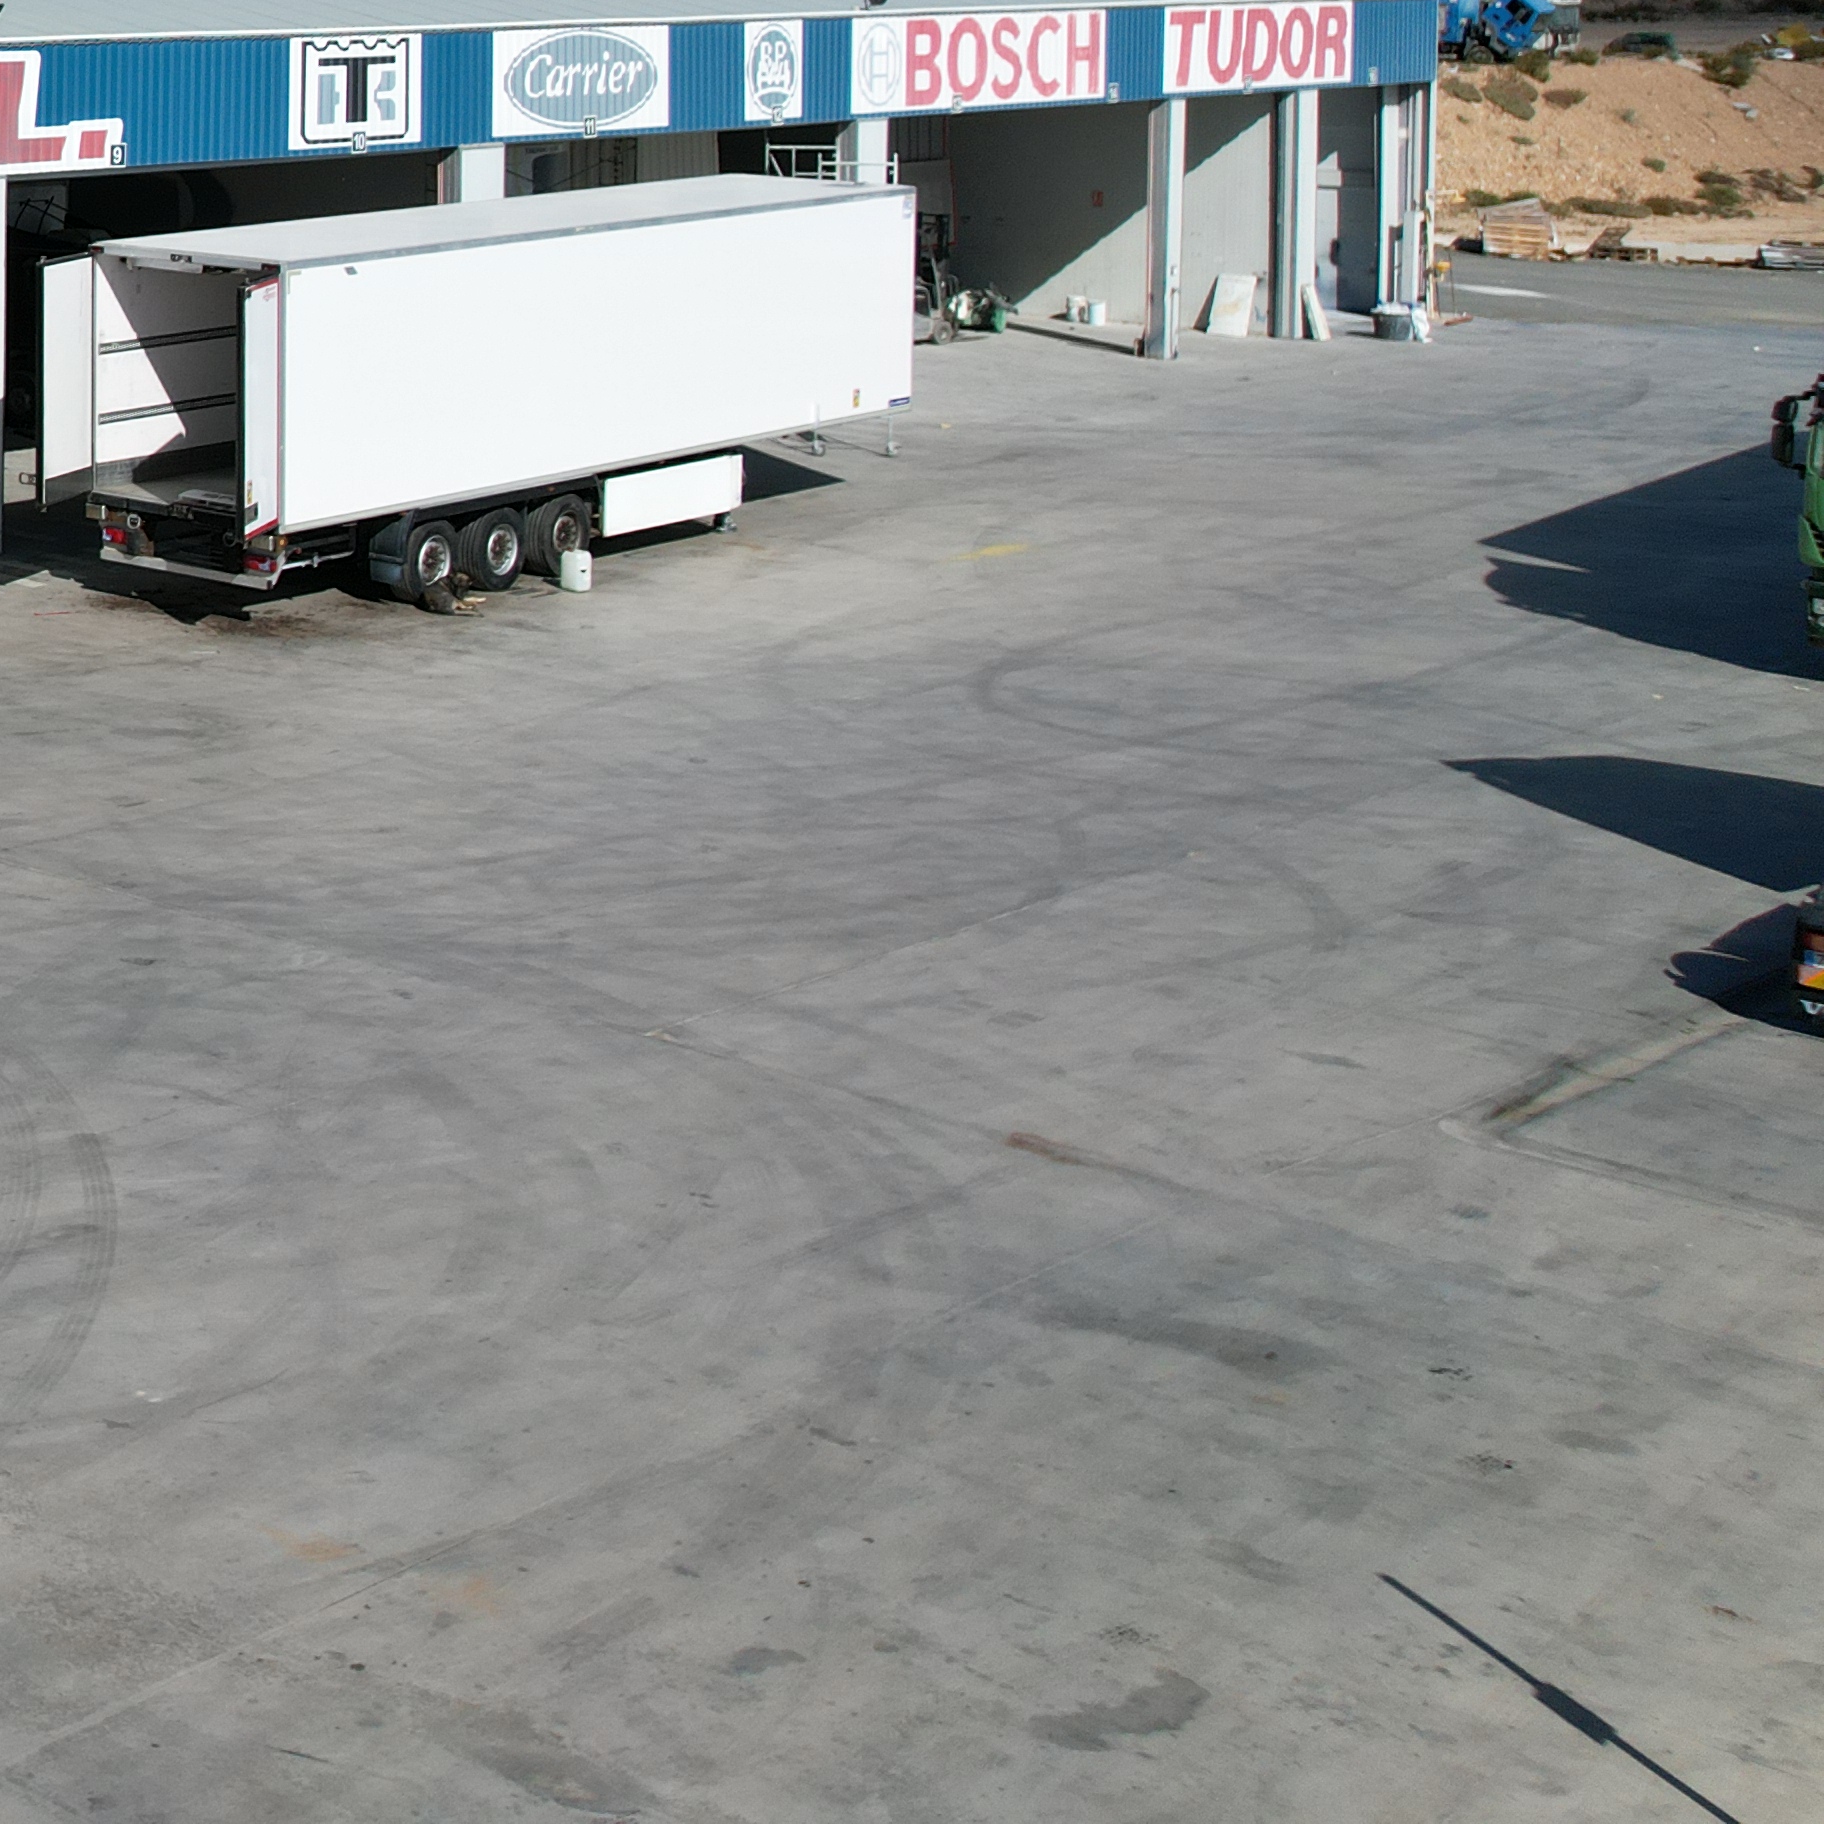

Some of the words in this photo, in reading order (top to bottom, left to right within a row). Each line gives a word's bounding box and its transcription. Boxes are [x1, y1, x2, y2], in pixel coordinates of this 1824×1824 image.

[524, 51, 643, 98] Carrier
[906, 14, 1100, 105] BOSCH
[1170, 6, 1347, 85] TUDOR
